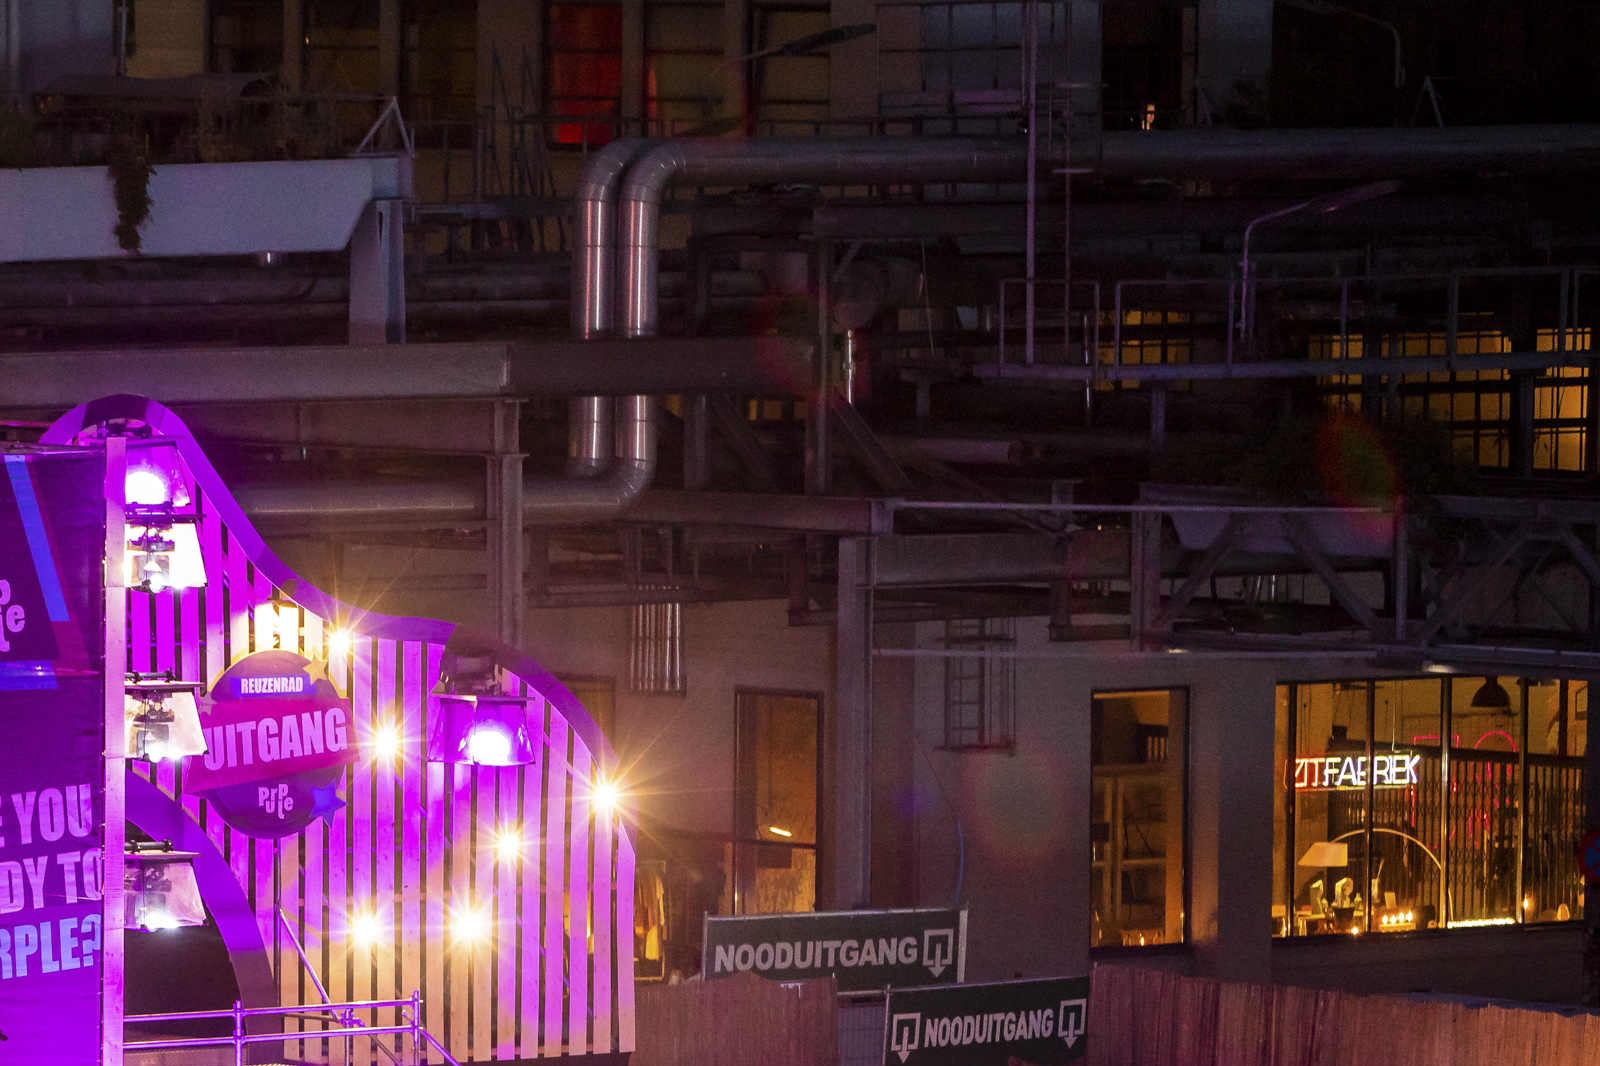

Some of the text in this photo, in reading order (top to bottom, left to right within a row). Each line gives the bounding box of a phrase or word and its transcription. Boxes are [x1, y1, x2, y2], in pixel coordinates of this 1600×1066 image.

[240, 676, 304, 694] REUZENRAD
[202, 707, 348, 772] UITGANG
[11, 783, 93, 845] YOU
[56, 847, 102, 905] TO
[714, 936, 918, 973] NOODUITGANG
[923, 1008, 1054, 1049] NOODUITGANG
